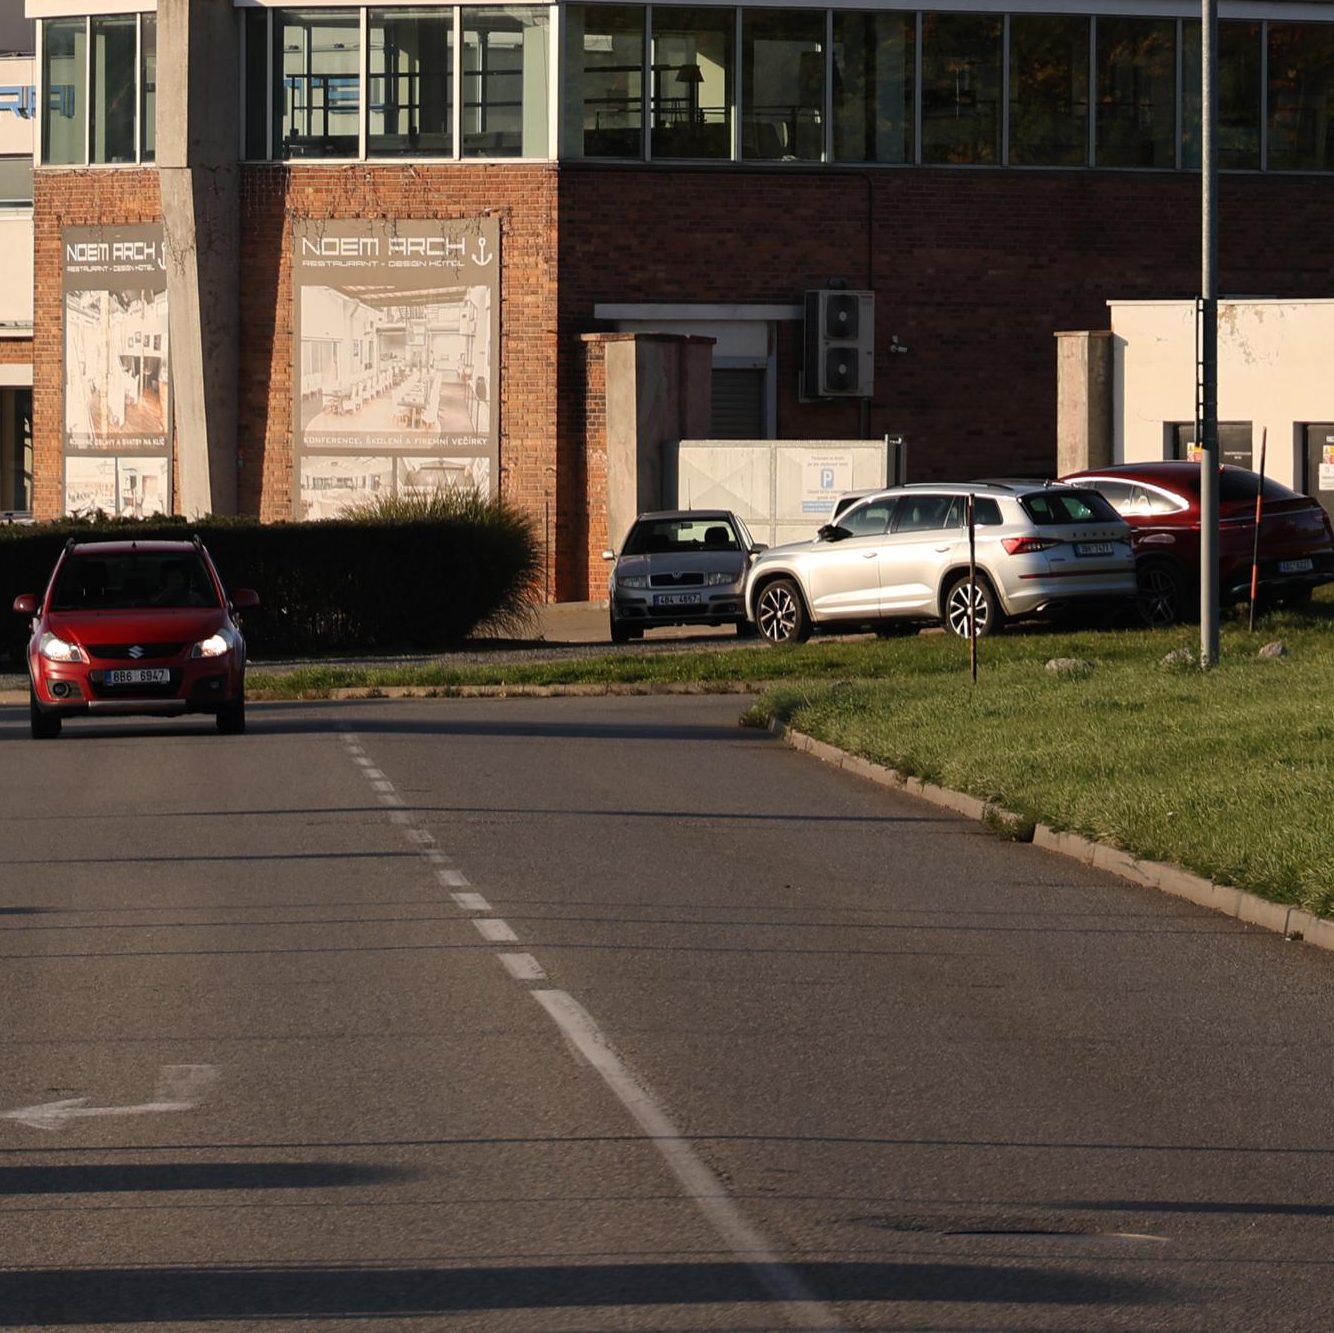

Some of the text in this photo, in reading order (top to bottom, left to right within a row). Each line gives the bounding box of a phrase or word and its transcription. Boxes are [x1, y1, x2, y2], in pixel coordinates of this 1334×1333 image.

[67, 242, 156, 262] NOEM ARCH
[302, 237, 465, 255] NOEM ARCH
[303, 436, 363, 445] KONFERENCE,
[365, 434, 403, 444] ŠKOLENÍ
[415, 435, 449, 445] FIREMNÍ
[452, 435, 488, 445] VEČÍRKY
